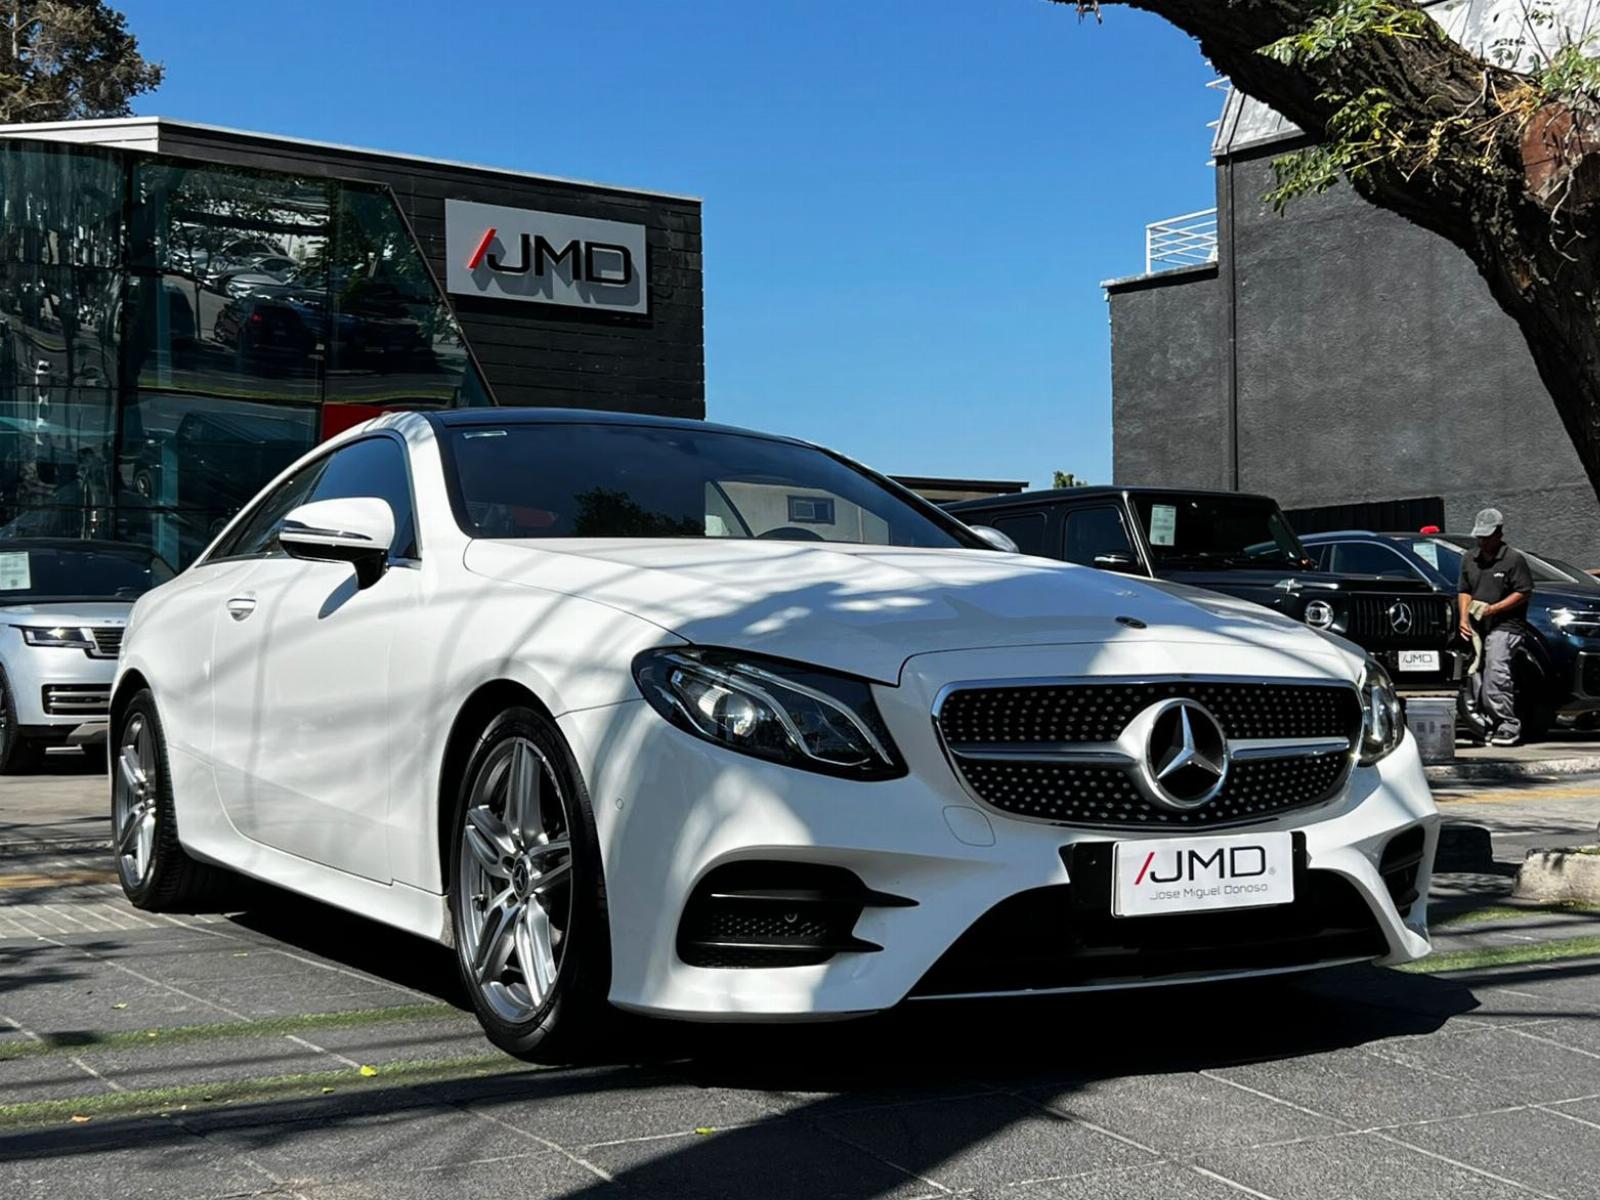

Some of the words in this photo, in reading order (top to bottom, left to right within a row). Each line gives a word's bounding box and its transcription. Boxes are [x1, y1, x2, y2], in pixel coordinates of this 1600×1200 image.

[1150, 889, 1180, 901] Jose
[1183, 885, 1220, 899] Miguel
[1224, 883, 1268, 895] Donoso
